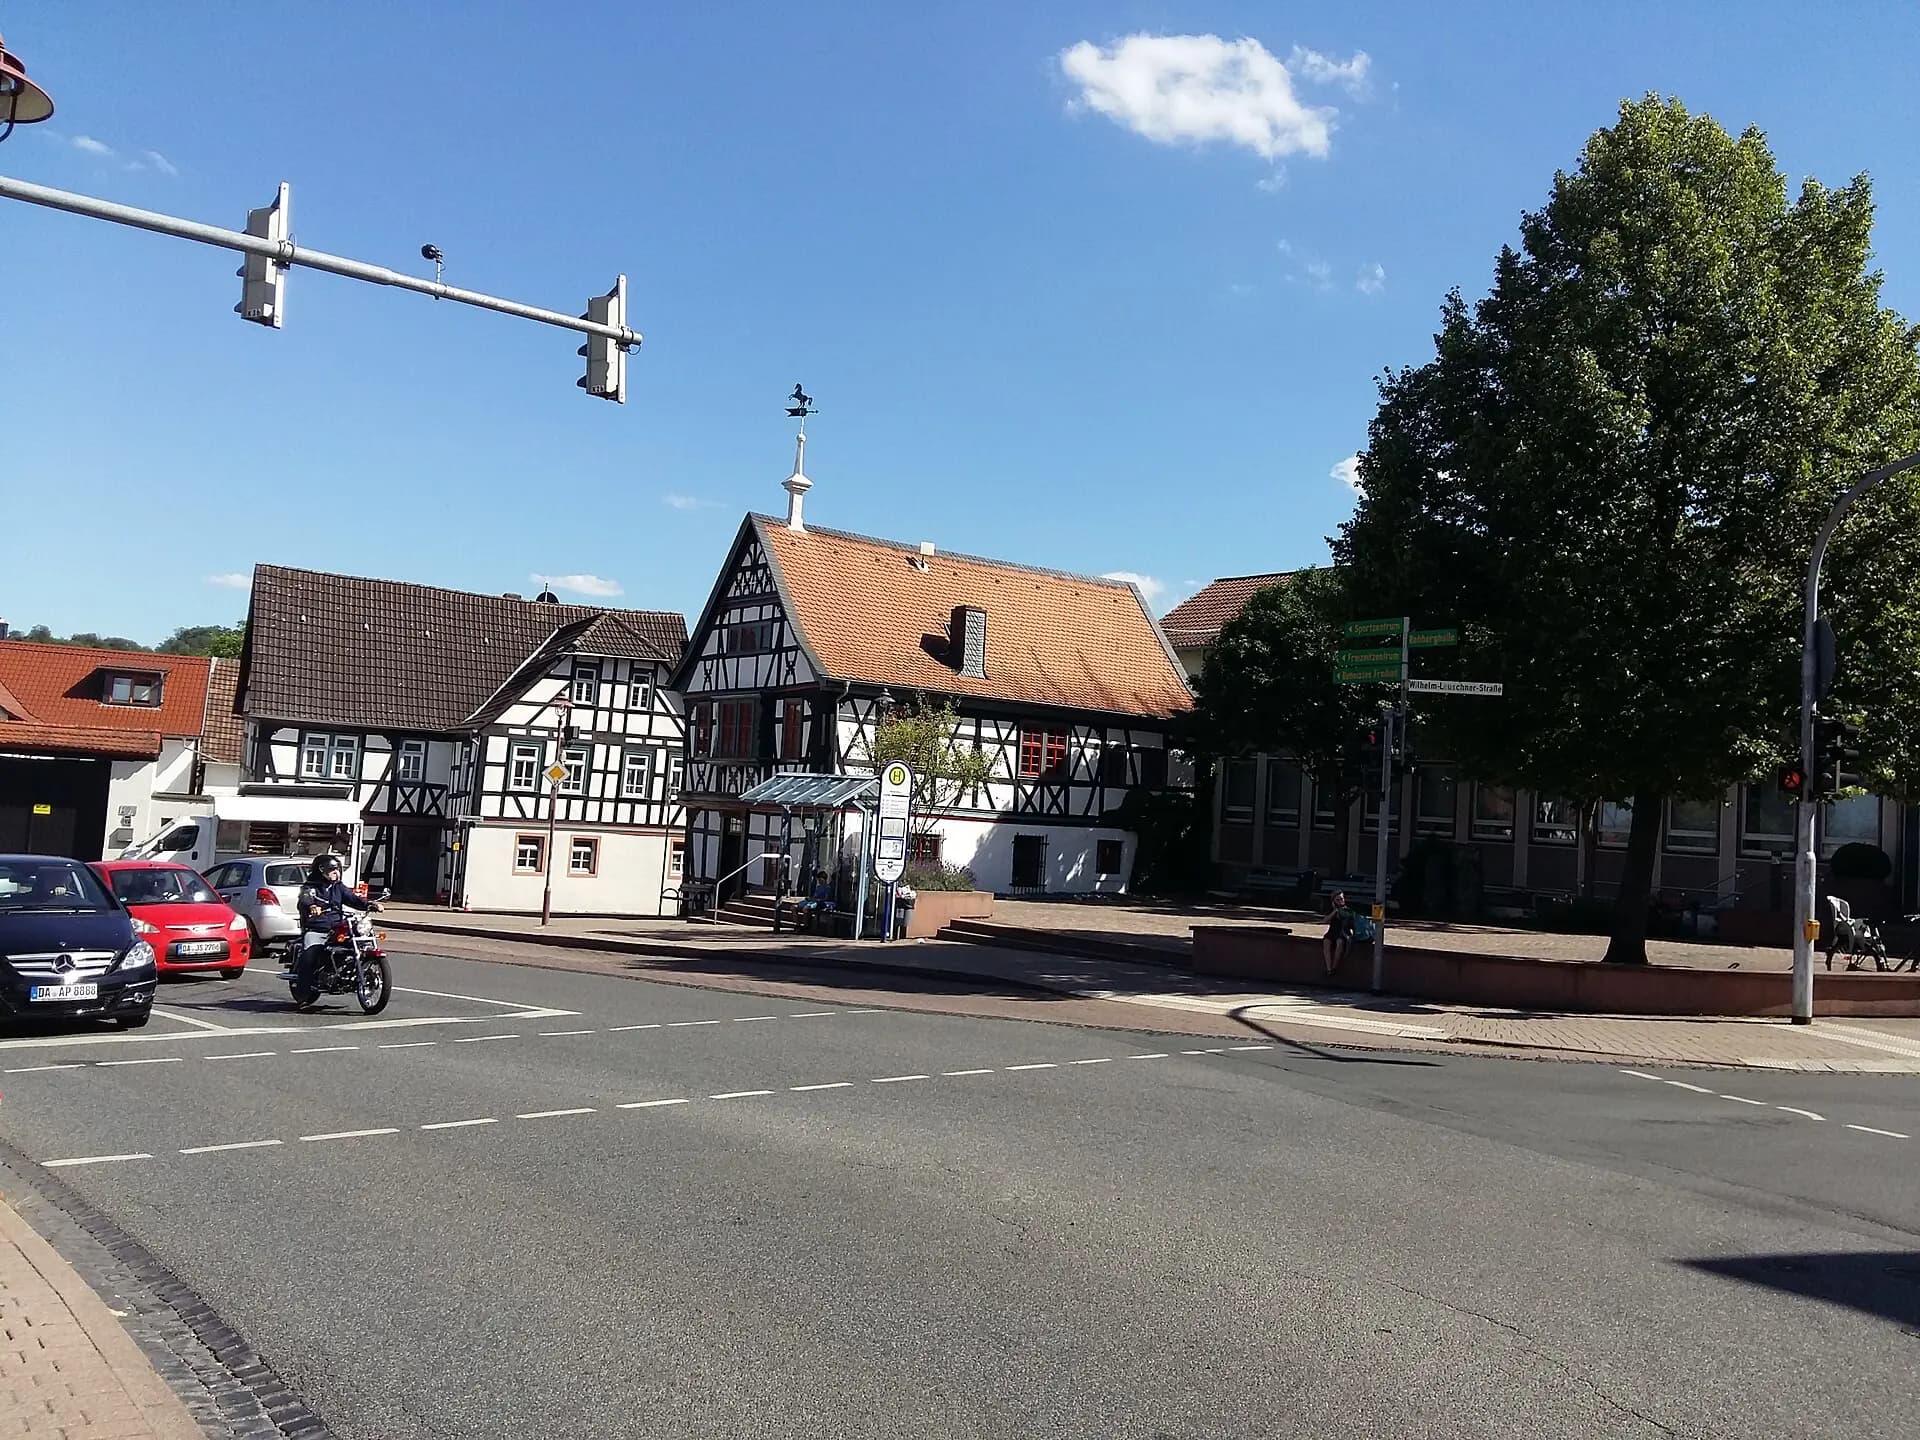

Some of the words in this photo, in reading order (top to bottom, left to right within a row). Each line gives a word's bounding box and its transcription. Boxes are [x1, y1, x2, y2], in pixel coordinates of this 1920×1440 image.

[1354, 622, 1400, 633] Sportzentrum
[1409, 680, 1502, 693] Wilhelm-Luschner-Straße
[38, 987, 51, 998] DA
[59, 986, 72, 997] AP
